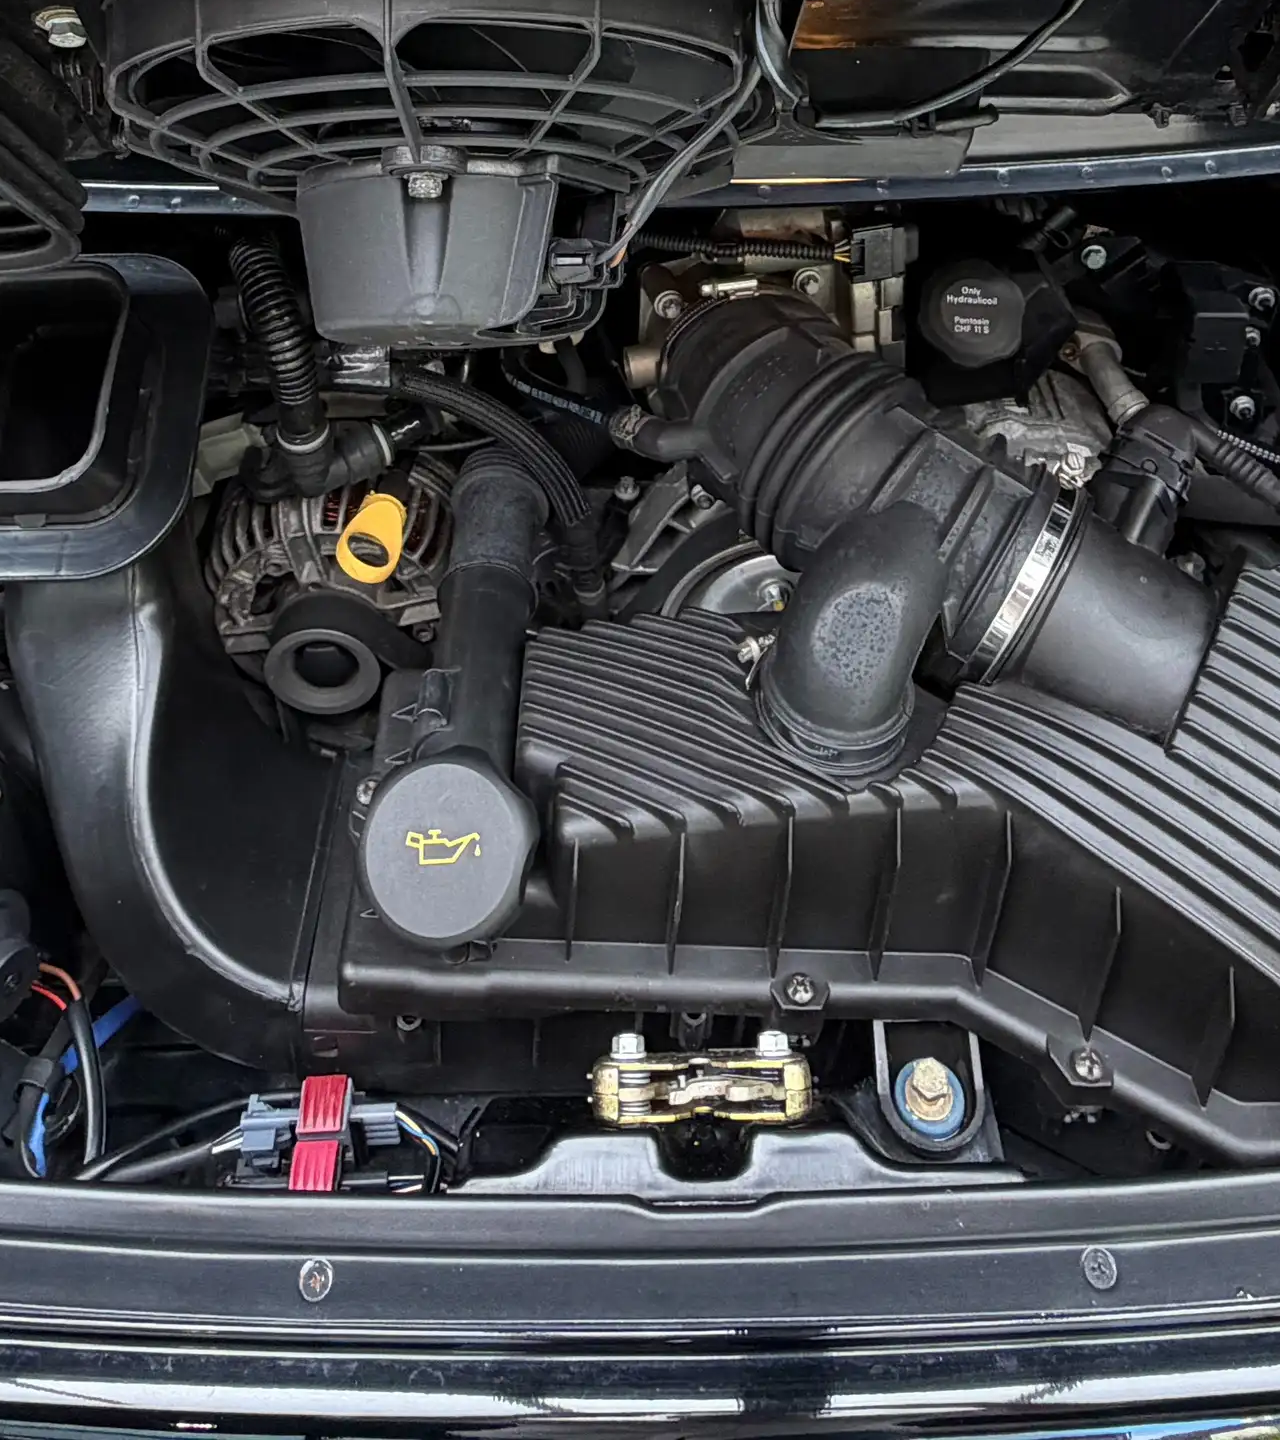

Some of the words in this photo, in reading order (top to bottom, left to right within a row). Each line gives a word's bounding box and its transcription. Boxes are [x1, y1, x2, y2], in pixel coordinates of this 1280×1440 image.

[961, 286, 981, 296] Only
[946, 294, 998, 305] Hydraulicoil
[954, 324, 971, 333] CHF
